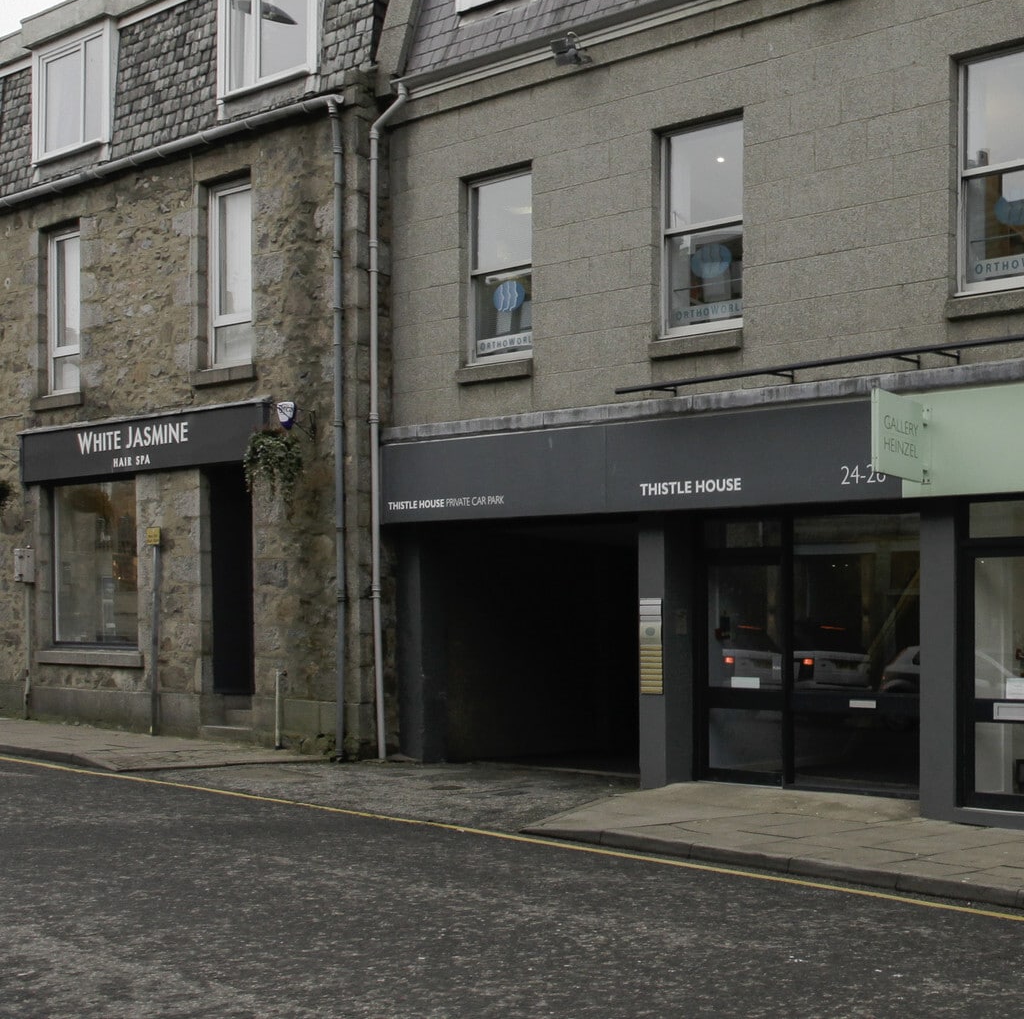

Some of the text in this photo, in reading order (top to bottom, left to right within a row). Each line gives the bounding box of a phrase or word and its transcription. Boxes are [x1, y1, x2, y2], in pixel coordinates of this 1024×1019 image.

[675, 302, 743, 321] ORTHOWORL
[883, 414, 920, 437] GALLERY
[77, 421, 189, 455] WHITE JASMINE
[883, 436, 919, 459] HEINZEL
[112, 455, 151, 468] HAIR SPA
[639, 478, 742, 497] THISTLE HOUSE
[388, 495, 504, 510] THISTLE HOUSE PRIVATE CAR PARK
